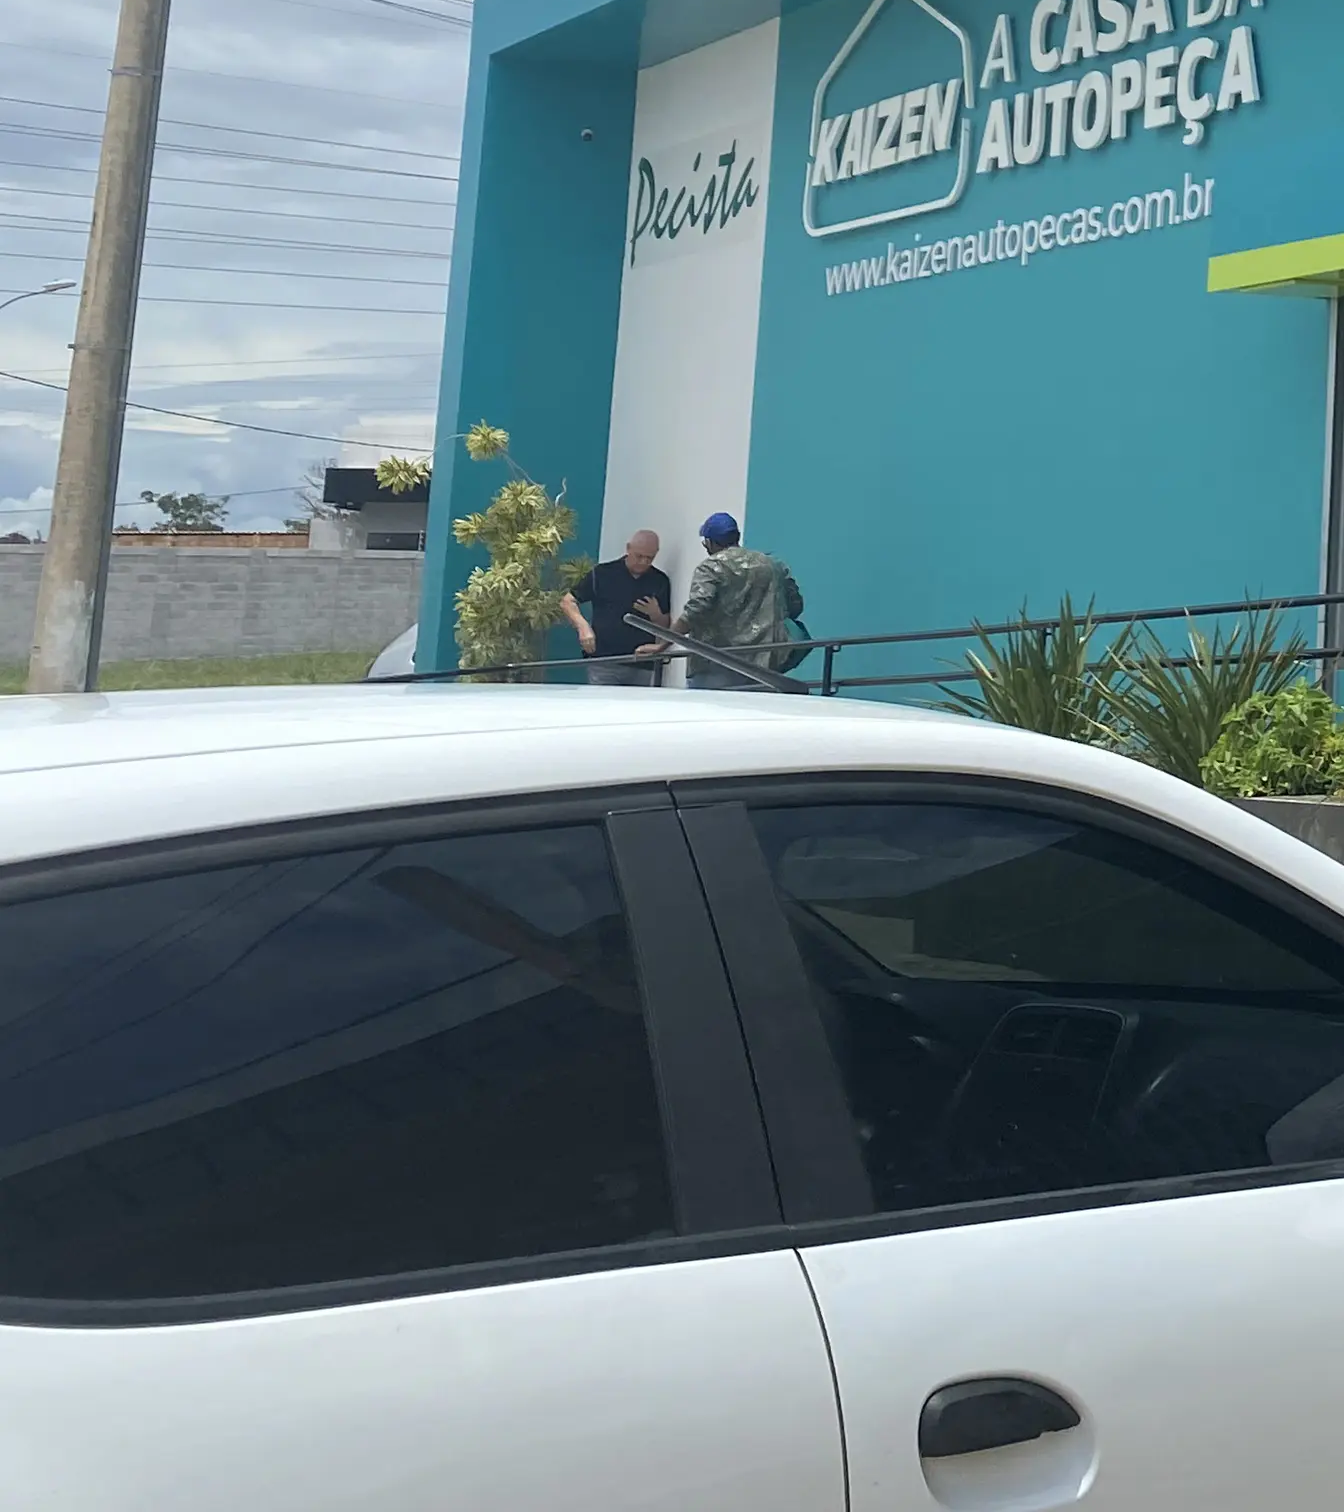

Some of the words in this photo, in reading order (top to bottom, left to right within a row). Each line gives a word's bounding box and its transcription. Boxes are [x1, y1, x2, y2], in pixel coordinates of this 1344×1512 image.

[976, 25, 1261, 175] AUTOPEÇA
[980, 13, 1015, 90] A
[810, 79, 963, 187] KAIZEN
[630, 138, 759, 269] Pecista
[825, 173, 1215, 296] www.kaizenautopecas.com.br
